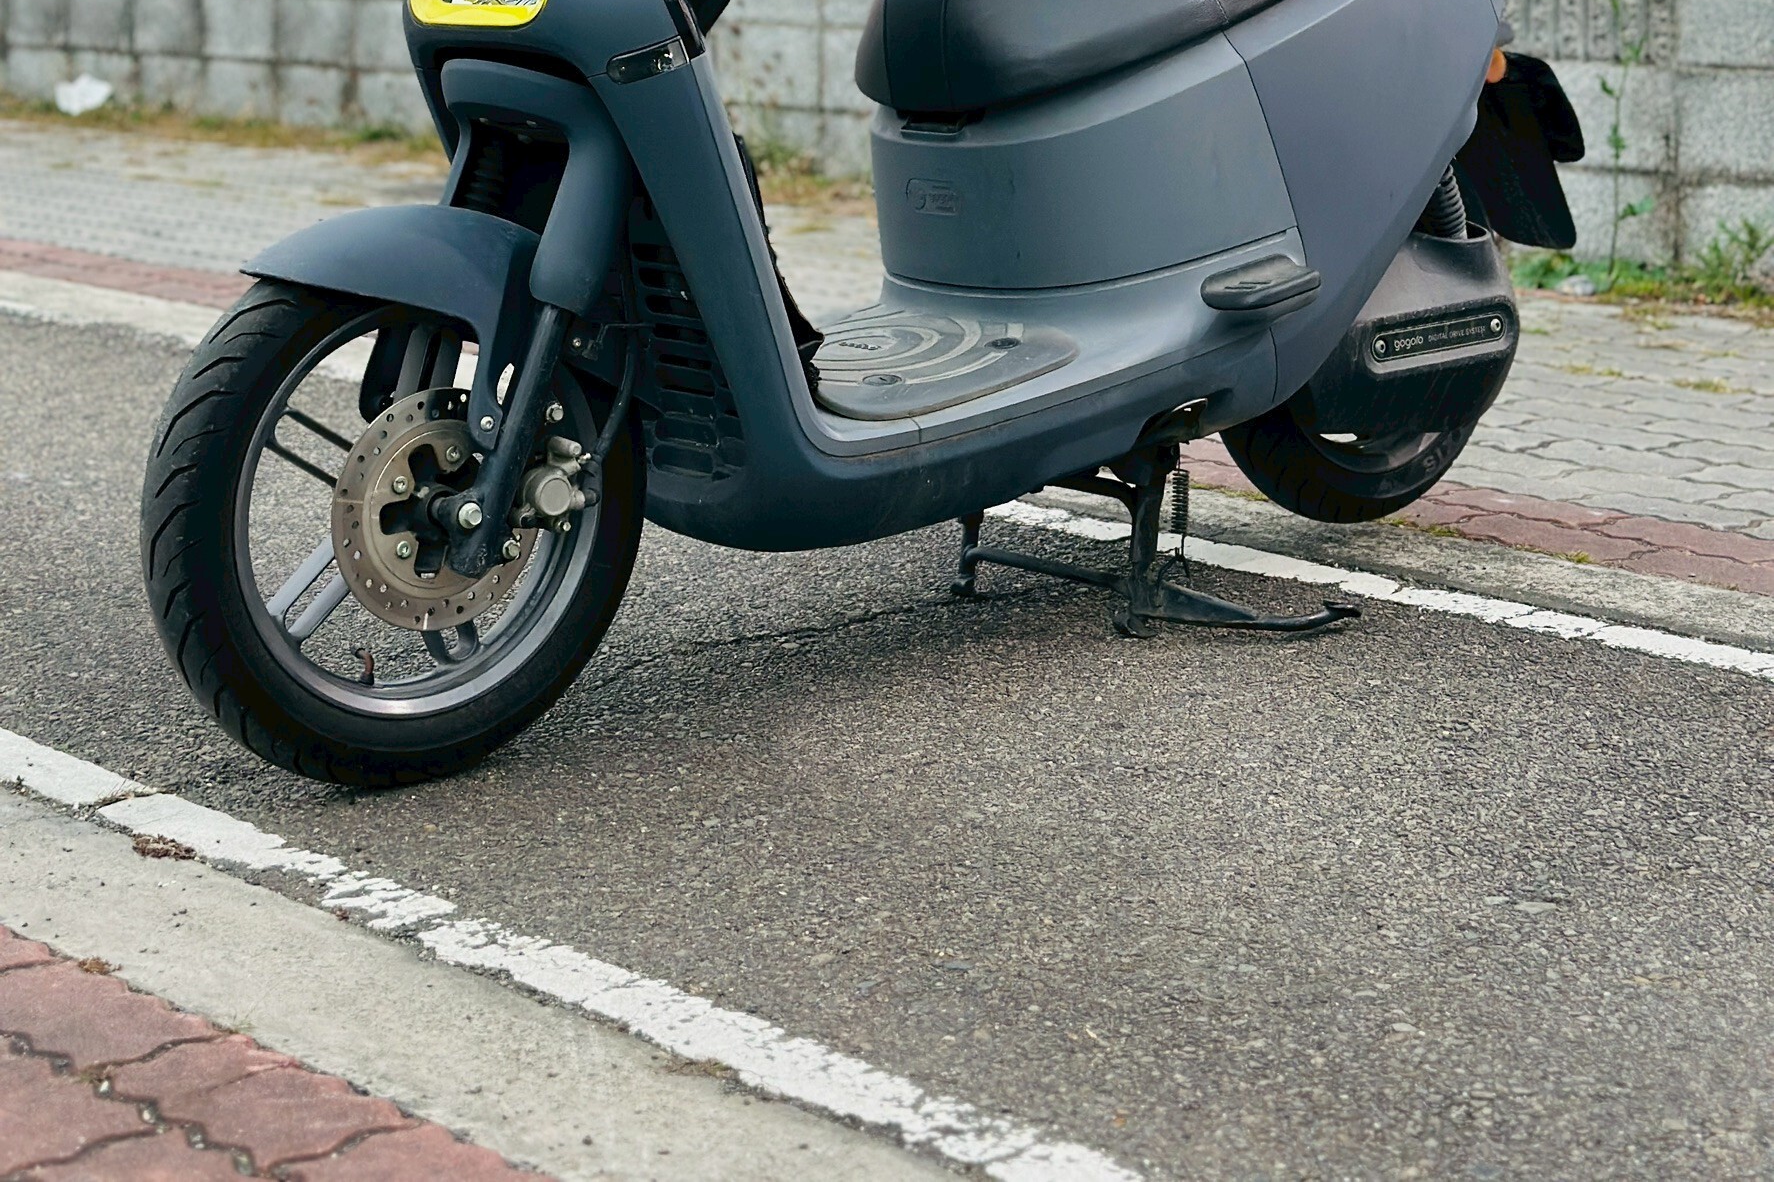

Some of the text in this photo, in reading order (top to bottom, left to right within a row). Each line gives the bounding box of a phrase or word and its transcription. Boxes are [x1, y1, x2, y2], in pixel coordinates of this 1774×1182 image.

[1394, 325, 1486, 351] gogoro DIGITAL DRIVE SYSTEM
